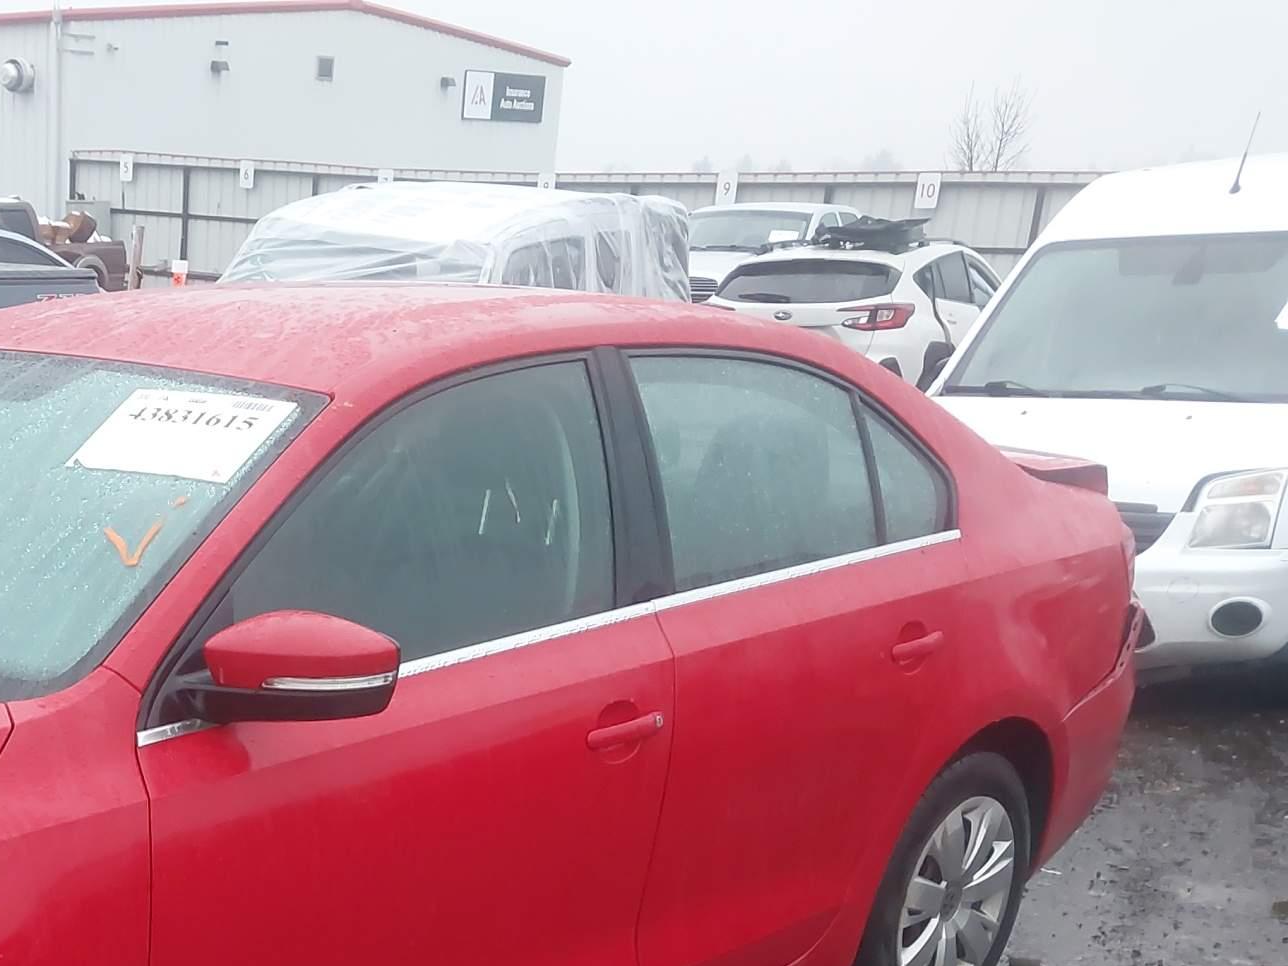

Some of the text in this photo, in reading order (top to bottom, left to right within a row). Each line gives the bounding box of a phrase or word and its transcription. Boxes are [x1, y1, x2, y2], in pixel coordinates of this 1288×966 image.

[123, 162, 129, 174] 5
[243, 169, 250, 181] 6
[722, 182, 731, 196] 9
[920, 183, 936, 199] 10
[129, 406, 260, 431] 43831615
